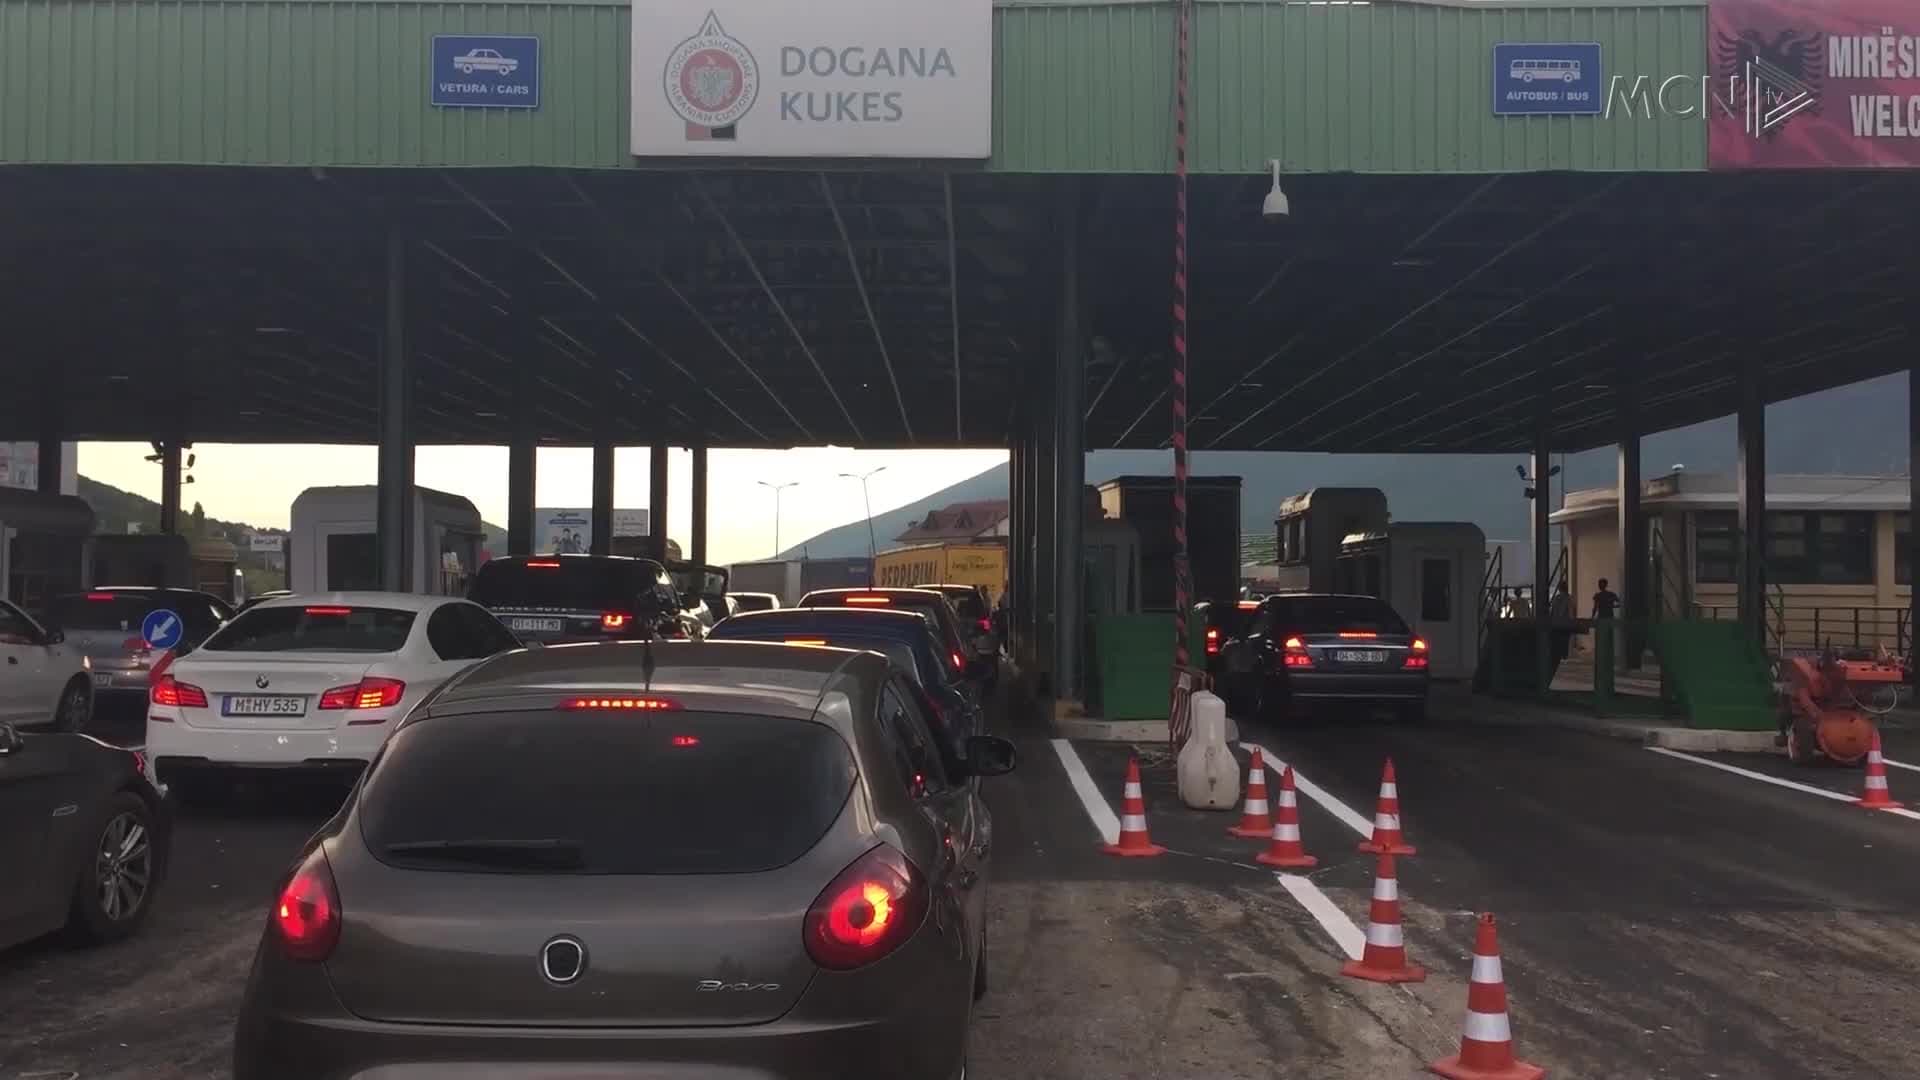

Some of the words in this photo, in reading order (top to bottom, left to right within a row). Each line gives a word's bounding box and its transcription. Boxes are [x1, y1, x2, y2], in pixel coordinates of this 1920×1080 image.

[780, 46, 956, 77] DOGANA
[439, 83, 488, 94] VETURA
[497, 85, 529, 95] CARS
[1506, 91, 1558, 101] AUTOBUS
[1567, 91, 1589, 101] BUS
[780, 92, 903, 121] KUKES
[273, 698, 299, 713] 535
[696, 980, 780, 991] Bravo
